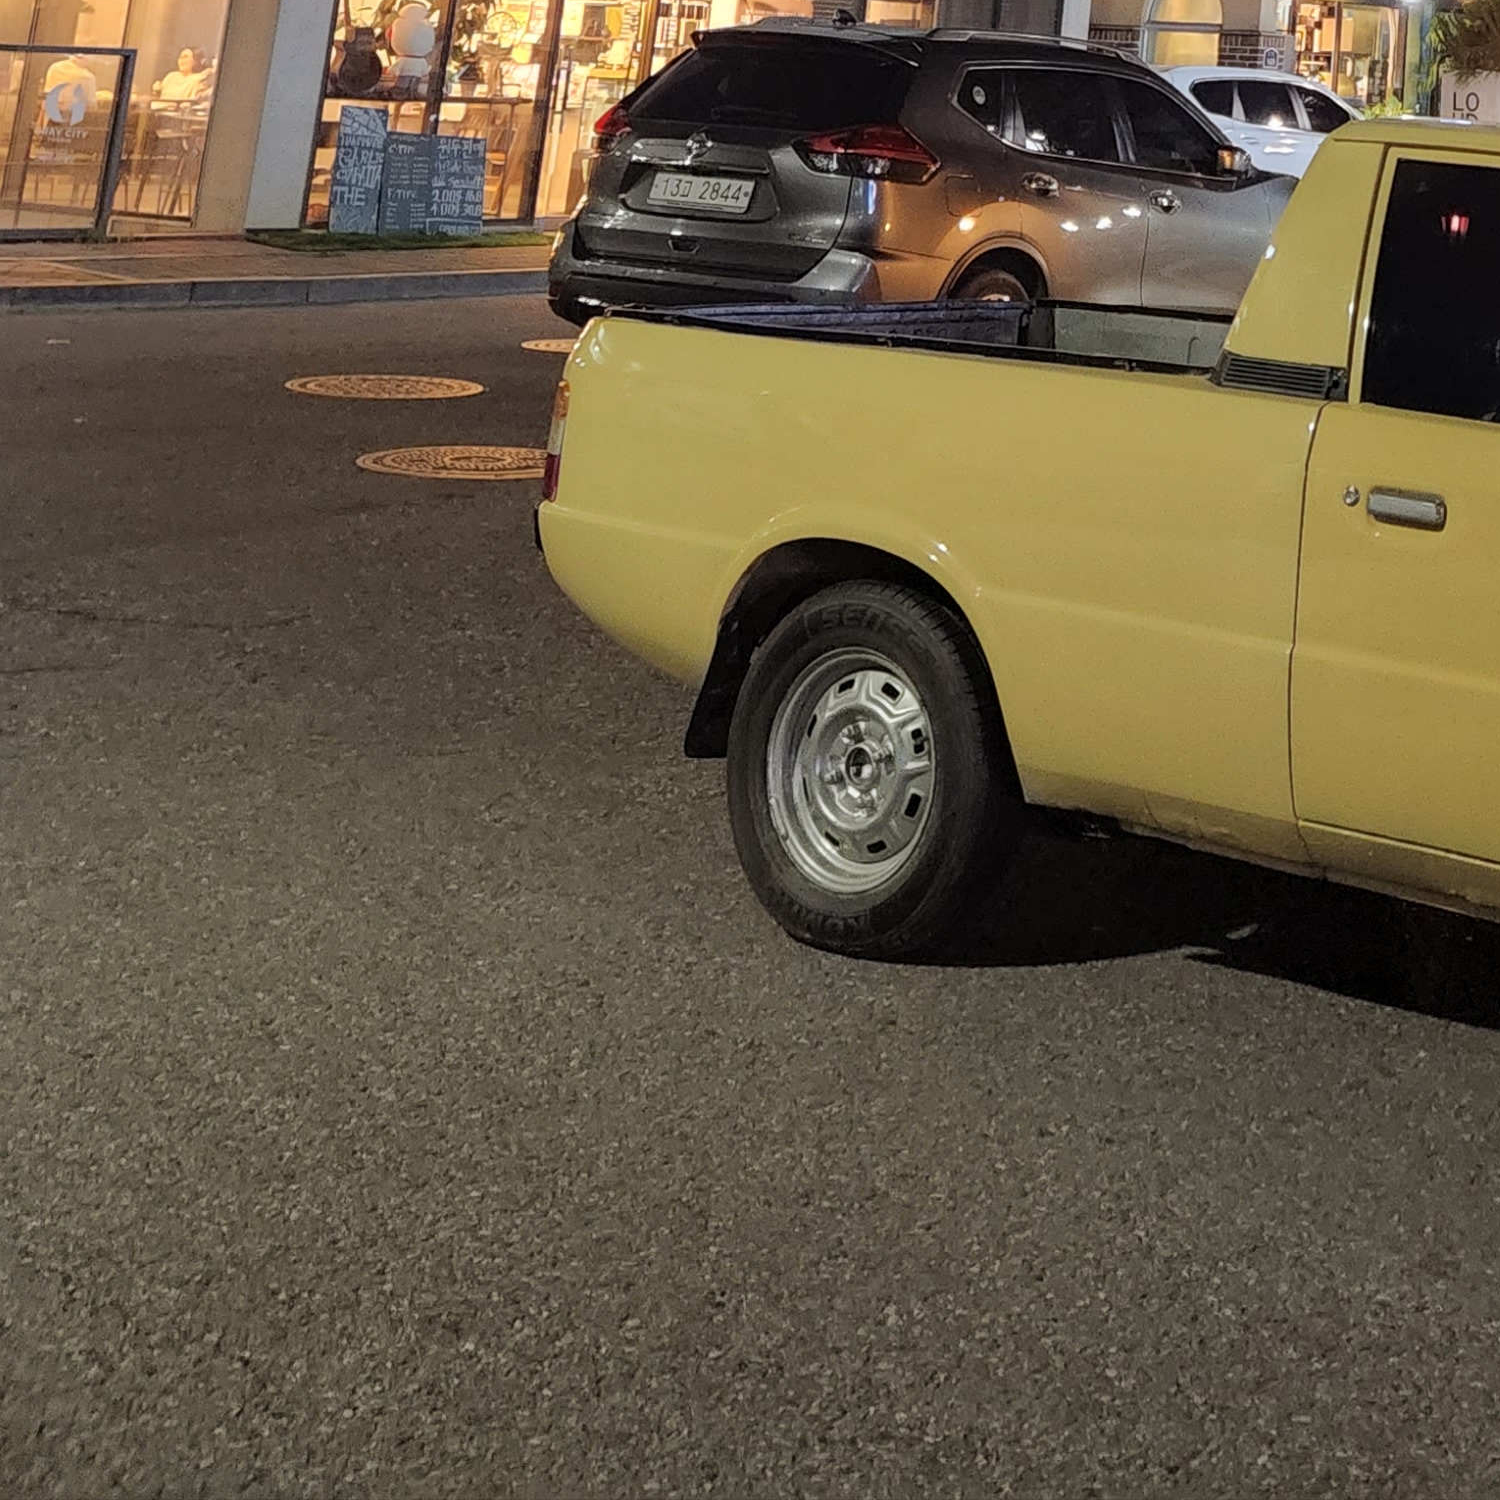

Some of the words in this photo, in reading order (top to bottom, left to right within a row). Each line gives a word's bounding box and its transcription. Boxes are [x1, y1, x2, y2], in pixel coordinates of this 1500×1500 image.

[1453, 91, 1480, 112] LO
[334, 186, 366, 206] THE
[698, 180, 743, 204] 2844
